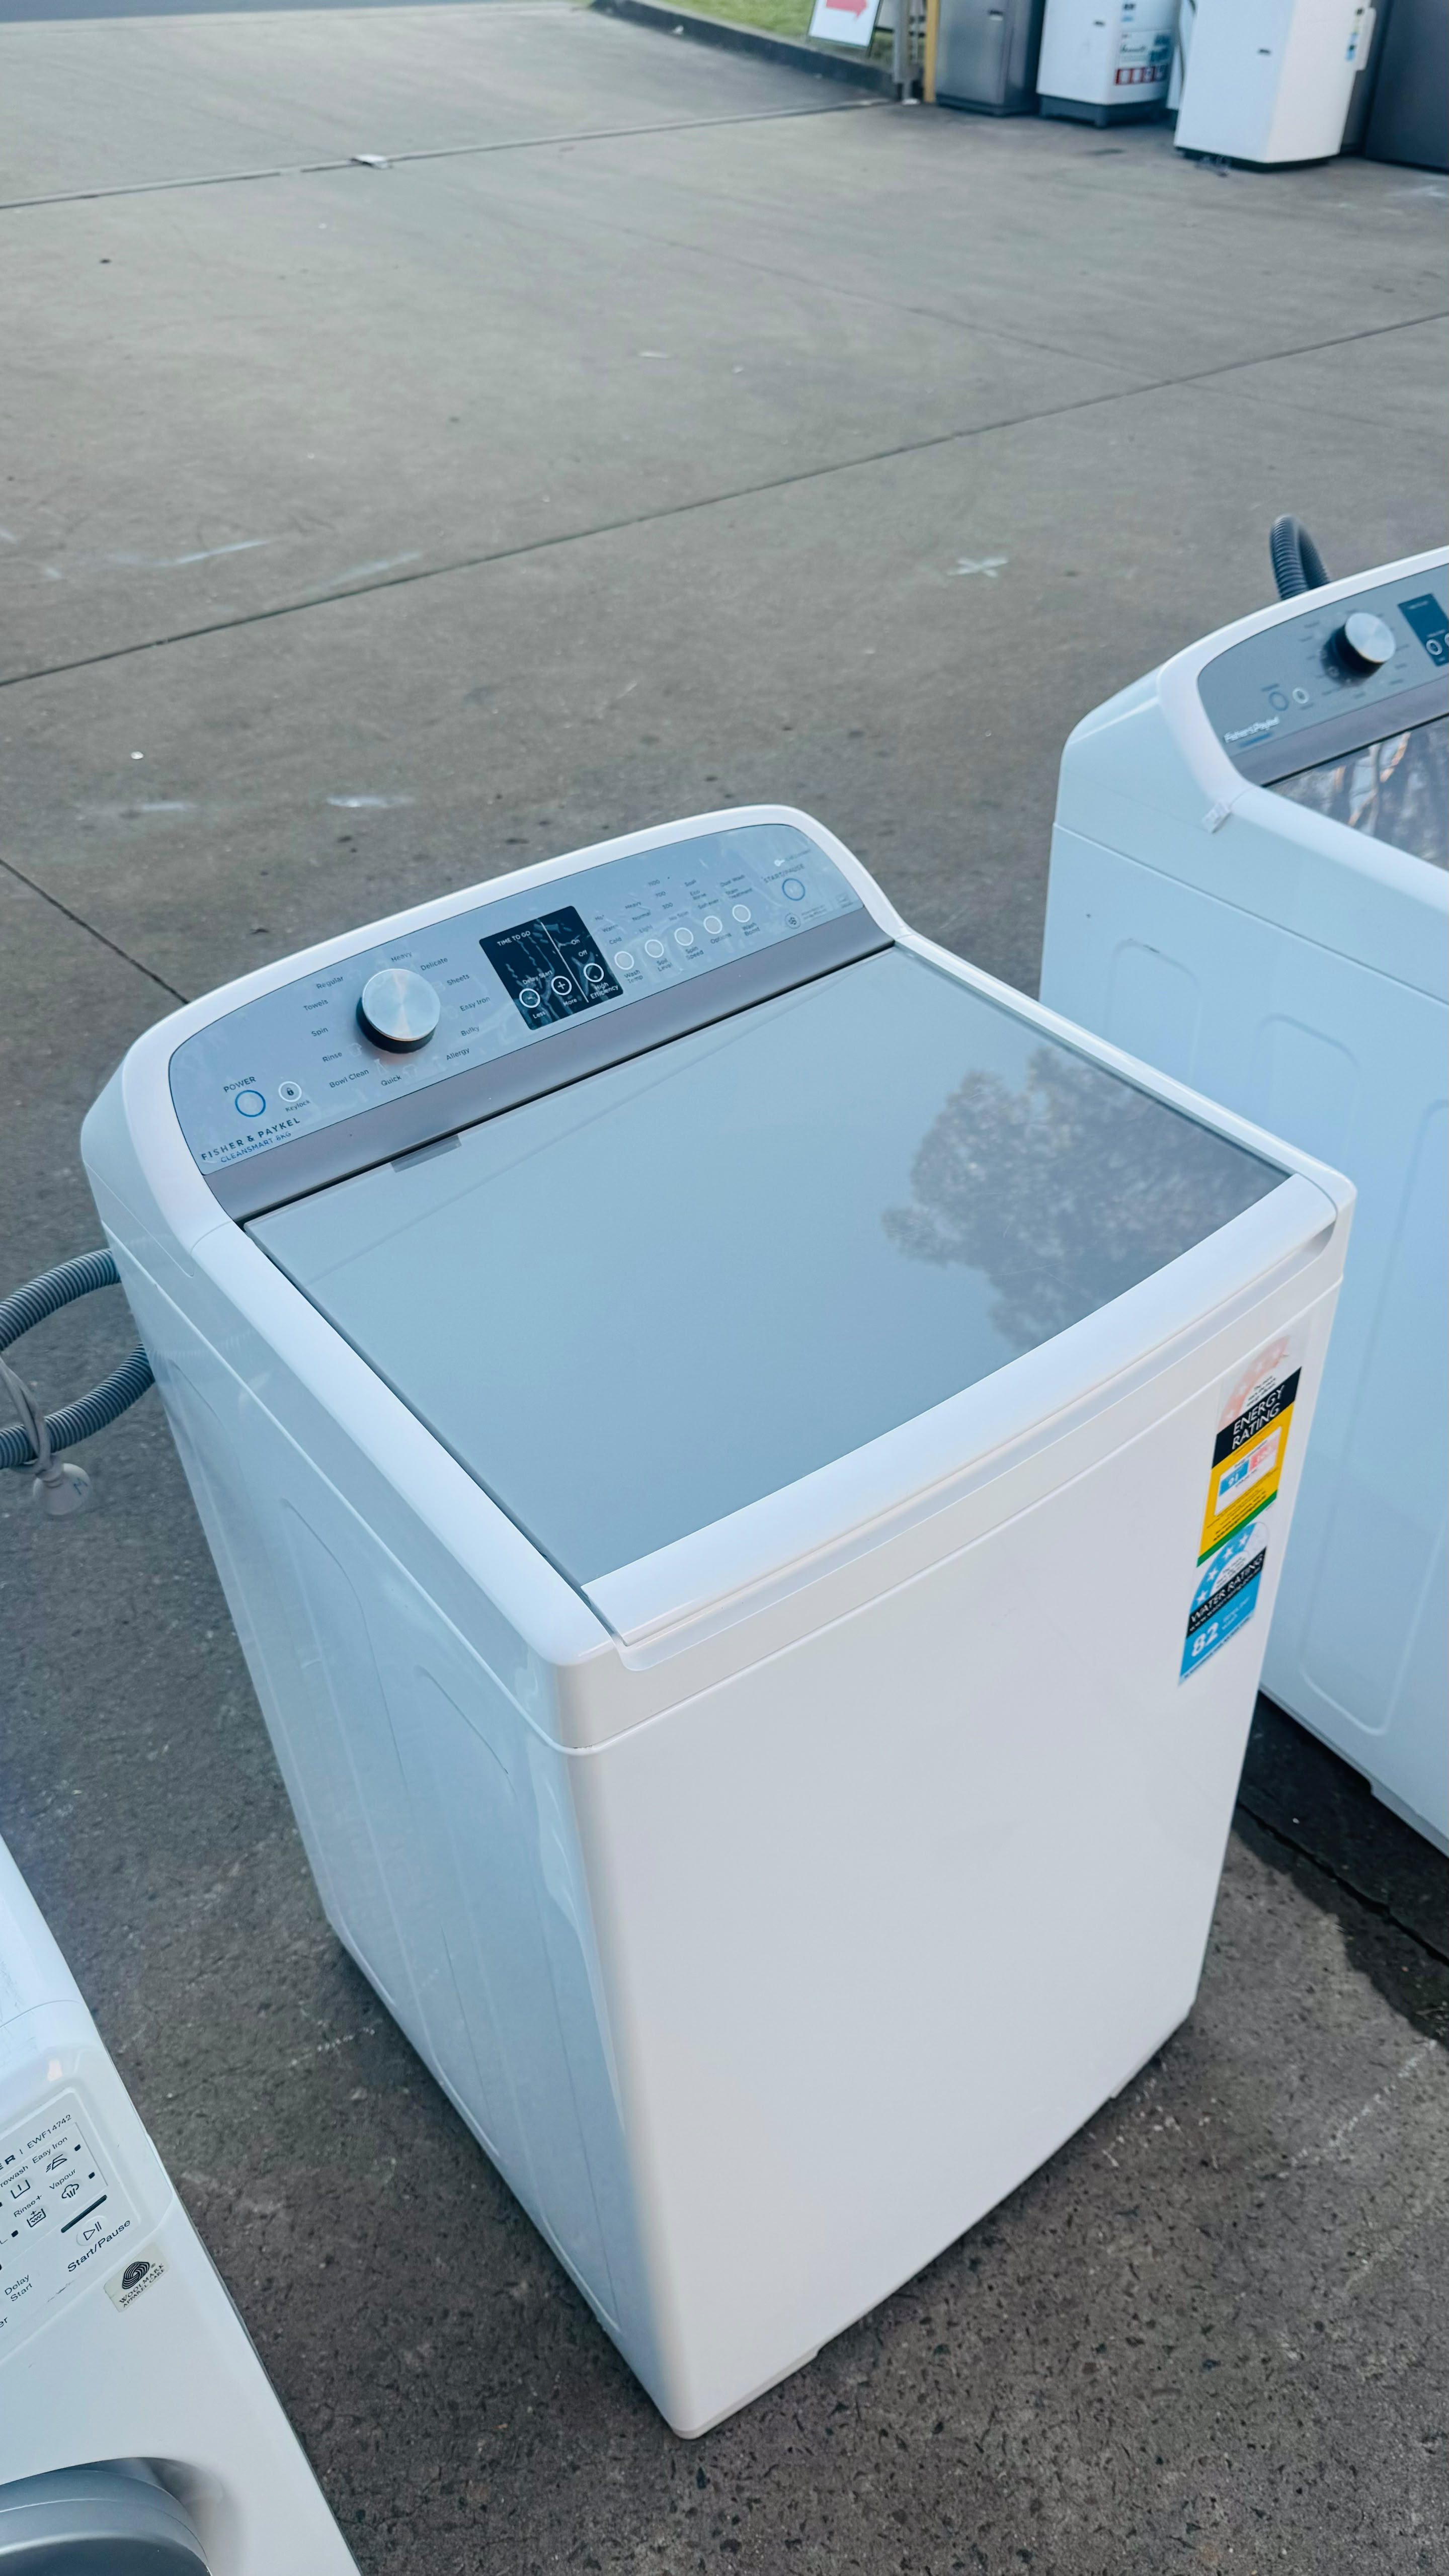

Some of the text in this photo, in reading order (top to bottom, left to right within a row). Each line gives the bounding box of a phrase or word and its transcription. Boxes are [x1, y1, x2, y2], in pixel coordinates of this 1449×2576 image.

[742, 922, 757, 931] Wash
[497, 937, 512, 946] TIME
[609, 937, 622, 945] Cold
[710, 933, 732, 944] Options
[685, 946, 699, 954] Spin
[391, 951, 413, 962] Heavy
[657, 958, 668, 966] Soil
[420, 957, 448, 971] Delicate
[658, 963, 673, 972] Level
[447, 974, 470, 986] Sheets
[624, 970, 640, 979] Wash
[316, 976, 344, 990] Regular
[590, 985, 619, 999] Efficiency
[303, 999, 328, 1011] Towels
[460, 996, 491, 1012] Easy Iron
[563, 998, 578, 1006] More
[532, 1011, 546, 1019] Less
[311, 1027, 329, 1037] Spin
[461, 1026, 479, 1037] Bulky
[322, 1052, 343, 1063] Rinse
[446, 1048, 470, 1060] Allergy
[223, 1076, 257, 1092] POWER
[329, 1069, 369, 1088] Bowl Clean
[381, 1074, 401, 1086] Quick
[285, 1099, 311, 1112] Keylock
[201, 1139, 244, 1160] FISHER
[258, 1117, 300, 1138] PAYKEL
[220, 1132, 292, 1163] CLEANSMART 8KG
[1233, 1385, 1284, 1435] ENERGY
[1232, 1403, 1280, 1450] RATING
[1191, 1589, 1226, 1623] WATER
[1227, 1554, 1263, 1592] RATING
[1191, 1622, 1219, 1657] 82
[27, 2114, 72, 2149] EWF14742
[32, 2136, 68, 2163] Easy Iron
[49, 2168, 76, 2190] Vapour
[119, 2263, 164, 2303] WOOLMARK
[11, 2283, 33, 2301] Start
